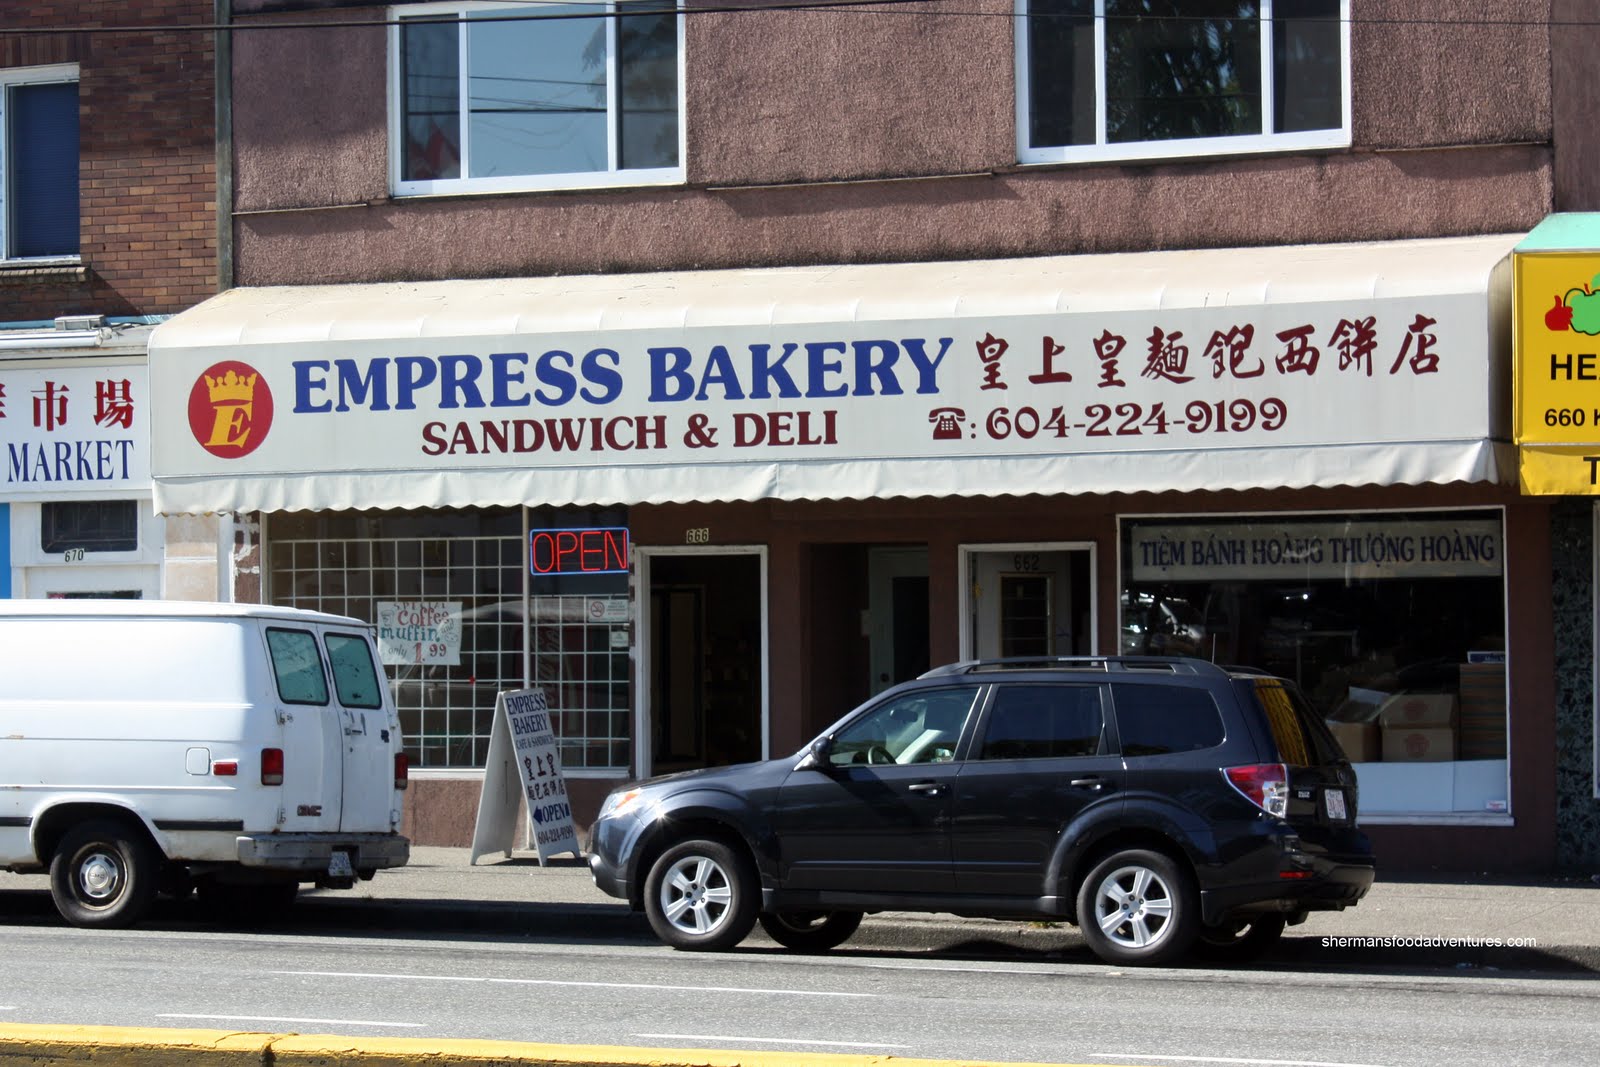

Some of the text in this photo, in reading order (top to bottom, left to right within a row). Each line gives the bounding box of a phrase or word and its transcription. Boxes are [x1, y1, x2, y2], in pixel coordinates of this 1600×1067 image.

[292, 337, 953, 413] EMPRESS BAKERY
[1550, 354, 1600, 380] HE
[0, 379, 134, 431] 市場
[1544, 408, 1585, 427] 660
[421, 410, 838, 456] SANDWICH & DELI
[8, 440, 134, 482] MARKET
[687, 529, 709, 543] 666
[1192, 533, 1246, 565] BÁNH
[1420, 529, 1495, 562] HOÀNG
[64, 548, 84, 563] 670
[532, 530, 628, 573] OPEN
[1014, 553, 1040, 571] 662
[505, 693, 547, 715] EMPRESS
[512, 713, 548, 735] BAKERY
[297, 804, 322, 816] GMC
[542, 802, 566, 823] OPEN
